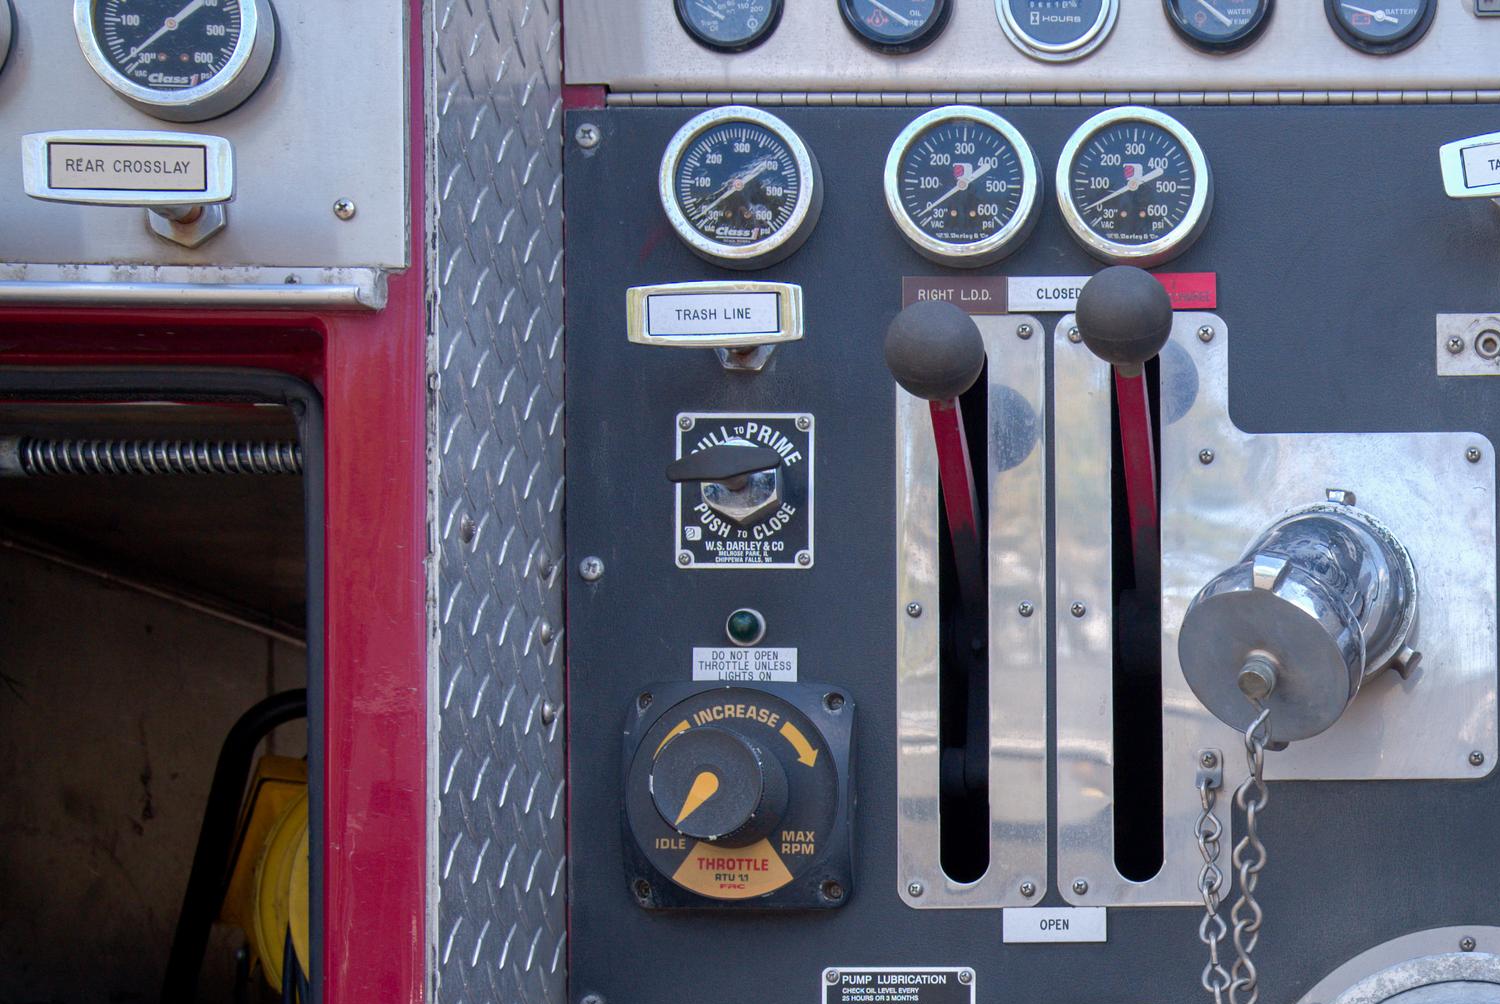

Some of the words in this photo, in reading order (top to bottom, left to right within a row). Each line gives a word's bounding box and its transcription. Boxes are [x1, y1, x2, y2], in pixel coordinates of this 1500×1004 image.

[1042, 15, 1081, 23] HOURS
[954, 143, 975, 154] 300
[930, 154, 950, 165] 200
[65, 158, 105, 172] REAR
[113, 160, 191, 174] CROSSLAY
[920, 177, 939, 188] 100
[986, 181, 1006, 192] 500
[977, 204, 998, 216] 600
[918, 289, 954, 301] RIGHT
[960, 289, 992, 300] L.D.D.
[1036, 288, 1082, 300] CLOSED
[675, 308, 717, 321] TRASH
[724, 307, 751, 319] LINE
[694, 503, 731, 538] PUSH
[737, 530, 748, 538] TO
[753, 502, 796, 540] CLOSE
[705, 541, 725, 551] W.S.
[726, 541, 762, 551] DARLEY
[763, 541, 770, 551] &
[772, 541, 784, 551] CO
[712, 651, 725, 660] DO
[730, 651, 749, 660] NOT
[754, 651, 778, 660] OPEN
[698, 661, 749, 670] THROTTLE
[755, 661, 792, 670] UNLESS
[718, 672, 753, 681] LIGHTS
[759, 672, 771, 681] ON
[693, 704, 780, 727] INCREASE
[782, 831, 815, 842] MAX
[655, 838, 686, 849] IDLE
[781, 843, 814, 854] RPM
[697, 857, 769, 872] THROTTLE
[1040, 919, 1069, 930] OPEN
[842, 975, 872, 984] PUMP
[878, 975, 946, 984] LUBRICATION
